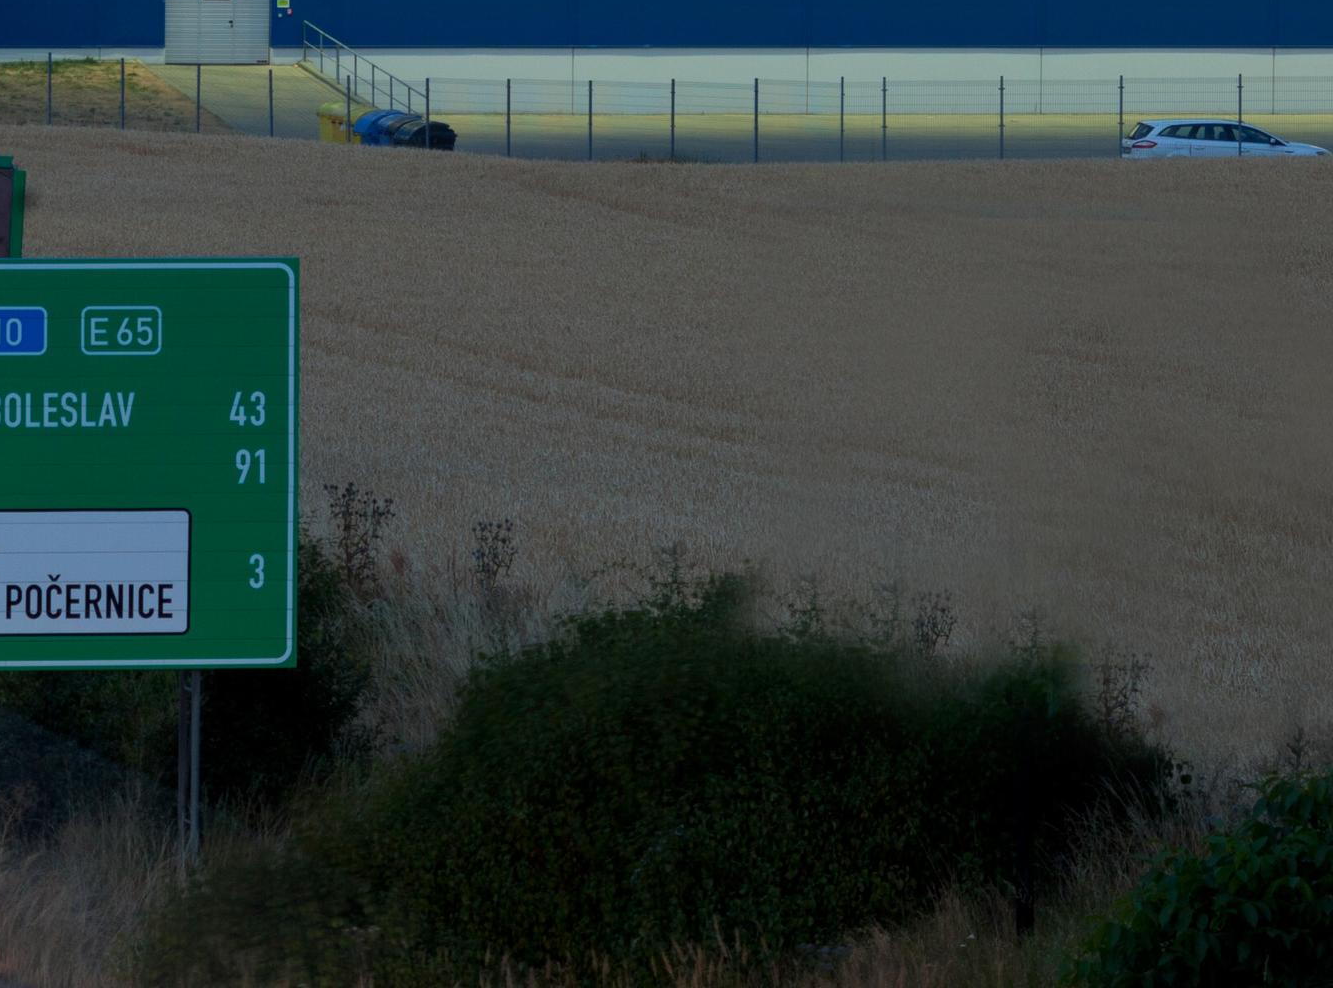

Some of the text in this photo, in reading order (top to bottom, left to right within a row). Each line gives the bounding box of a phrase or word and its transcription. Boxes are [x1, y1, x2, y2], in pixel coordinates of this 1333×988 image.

[230, 391, 266, 426] 43
[235, 449, 266, 484] 91
[249, 554, 265, 589] 3
[5, 574, 174, 620] POČERNICE
